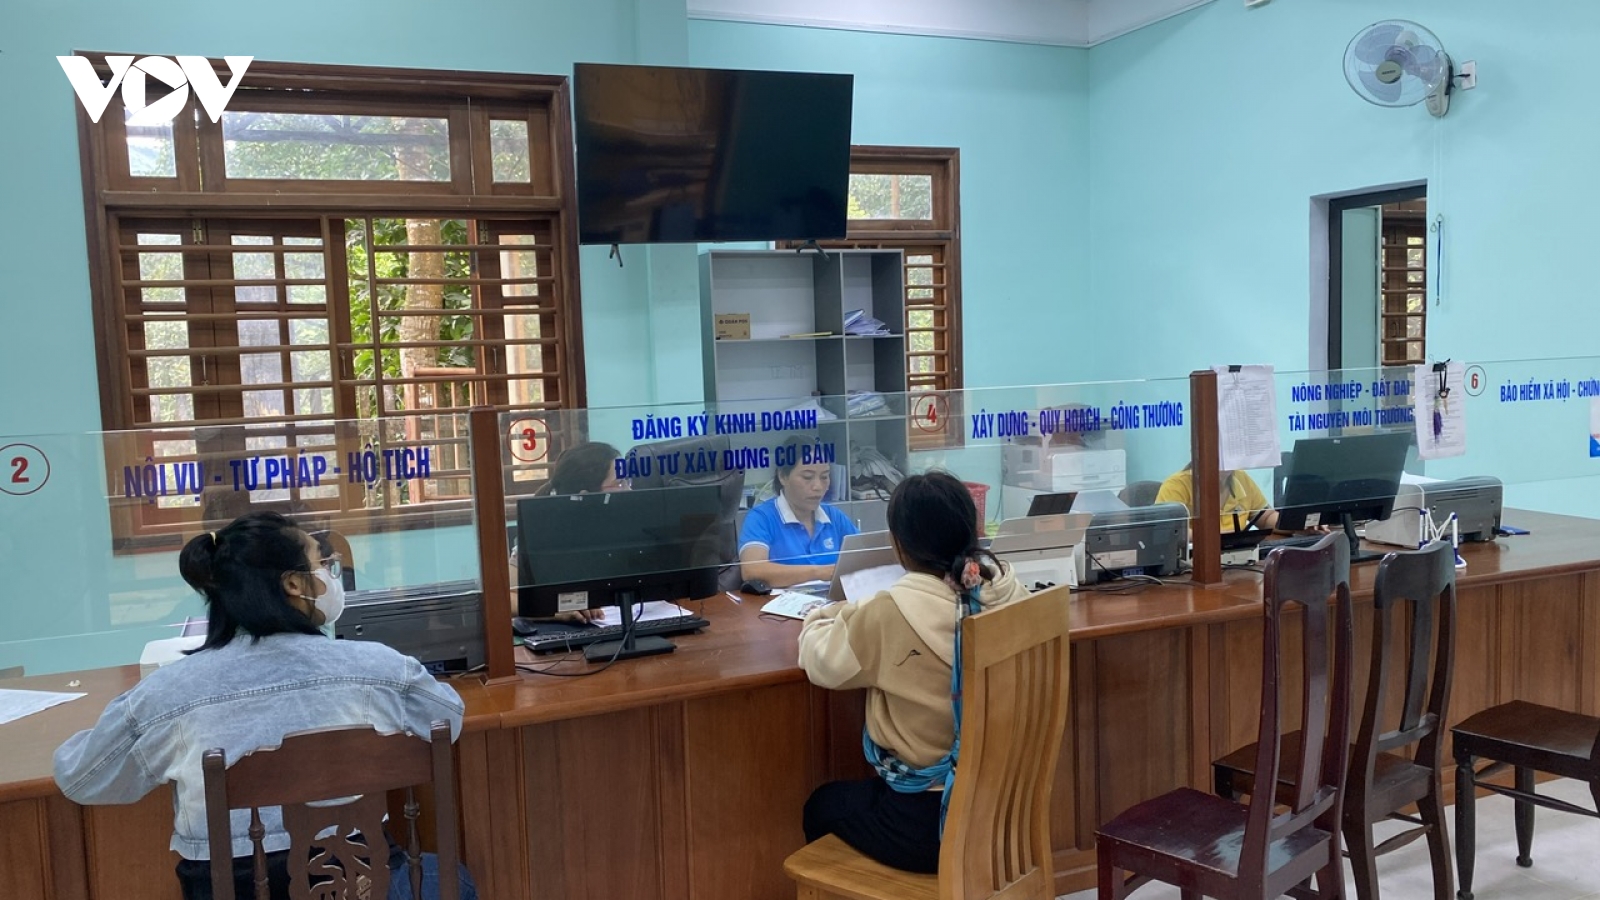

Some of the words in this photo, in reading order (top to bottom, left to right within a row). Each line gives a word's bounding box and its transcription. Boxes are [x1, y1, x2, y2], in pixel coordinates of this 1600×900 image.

[1292, 382, 1321, 402] NÔNG
[1325, 380, 1362, 402] NGHIỆP
[1372, 375, 1390, 397] ĐẤT
[1471, 373, 1479, 389] 6
[1500, 379, 1518, 402] BẢO
[1520, 376, 1541, 401] HIỂM
[1543, 379, 1555, 400] XÃ
[1556, 378, 1570, 403] HỘI
[632, 413, 682, 441] ĐĂNG
[687, 411, 709, 436] KÝ
[715, 412, 756, 435] KINH
[761, 409, 817, 432] DOANH
[927, 404, 937, 423] 4
[972, 408, 994, 438] XÂY
[997, 410, 1028, 442] DỰNG
[1040, 409, 1060, 436] QUY
[1064, 407, 1100, 437] HOẠCH
[1110, 400, 1139, 430] CÔNG
[1142, 400, 1183, 428] THƯƠNG
[1288, 411, 1305, 431] TÀI
[1308, 409, 1349, 430] NGUYÊN
[1353, 407, 1371, 427] MÔI
[1375, 404, 1413, 425] TRƯỜNG
[523, 428, 536, 451] 3
[10, 456, 30, 483] 2
[615, 448, 651, 479] ĐẦU
[656, 450, 680, 476] TƯ
[684, 447, 717, 474] XÂY
[723, 446, 770, 475] DỰNG
[775, 443, 797, 467] CƠ
[802, 436, 835, 466] BẢN
[124, 456, 167, 504] NỘI
[174, 460, 205, 502] VỤ
[229, 455, 260, 492] TƯ
[265, 449, 327, 489] PHÁP
[348, 443, 377, 490] HỘ
[382, 447, 430, 487] TỊCH
